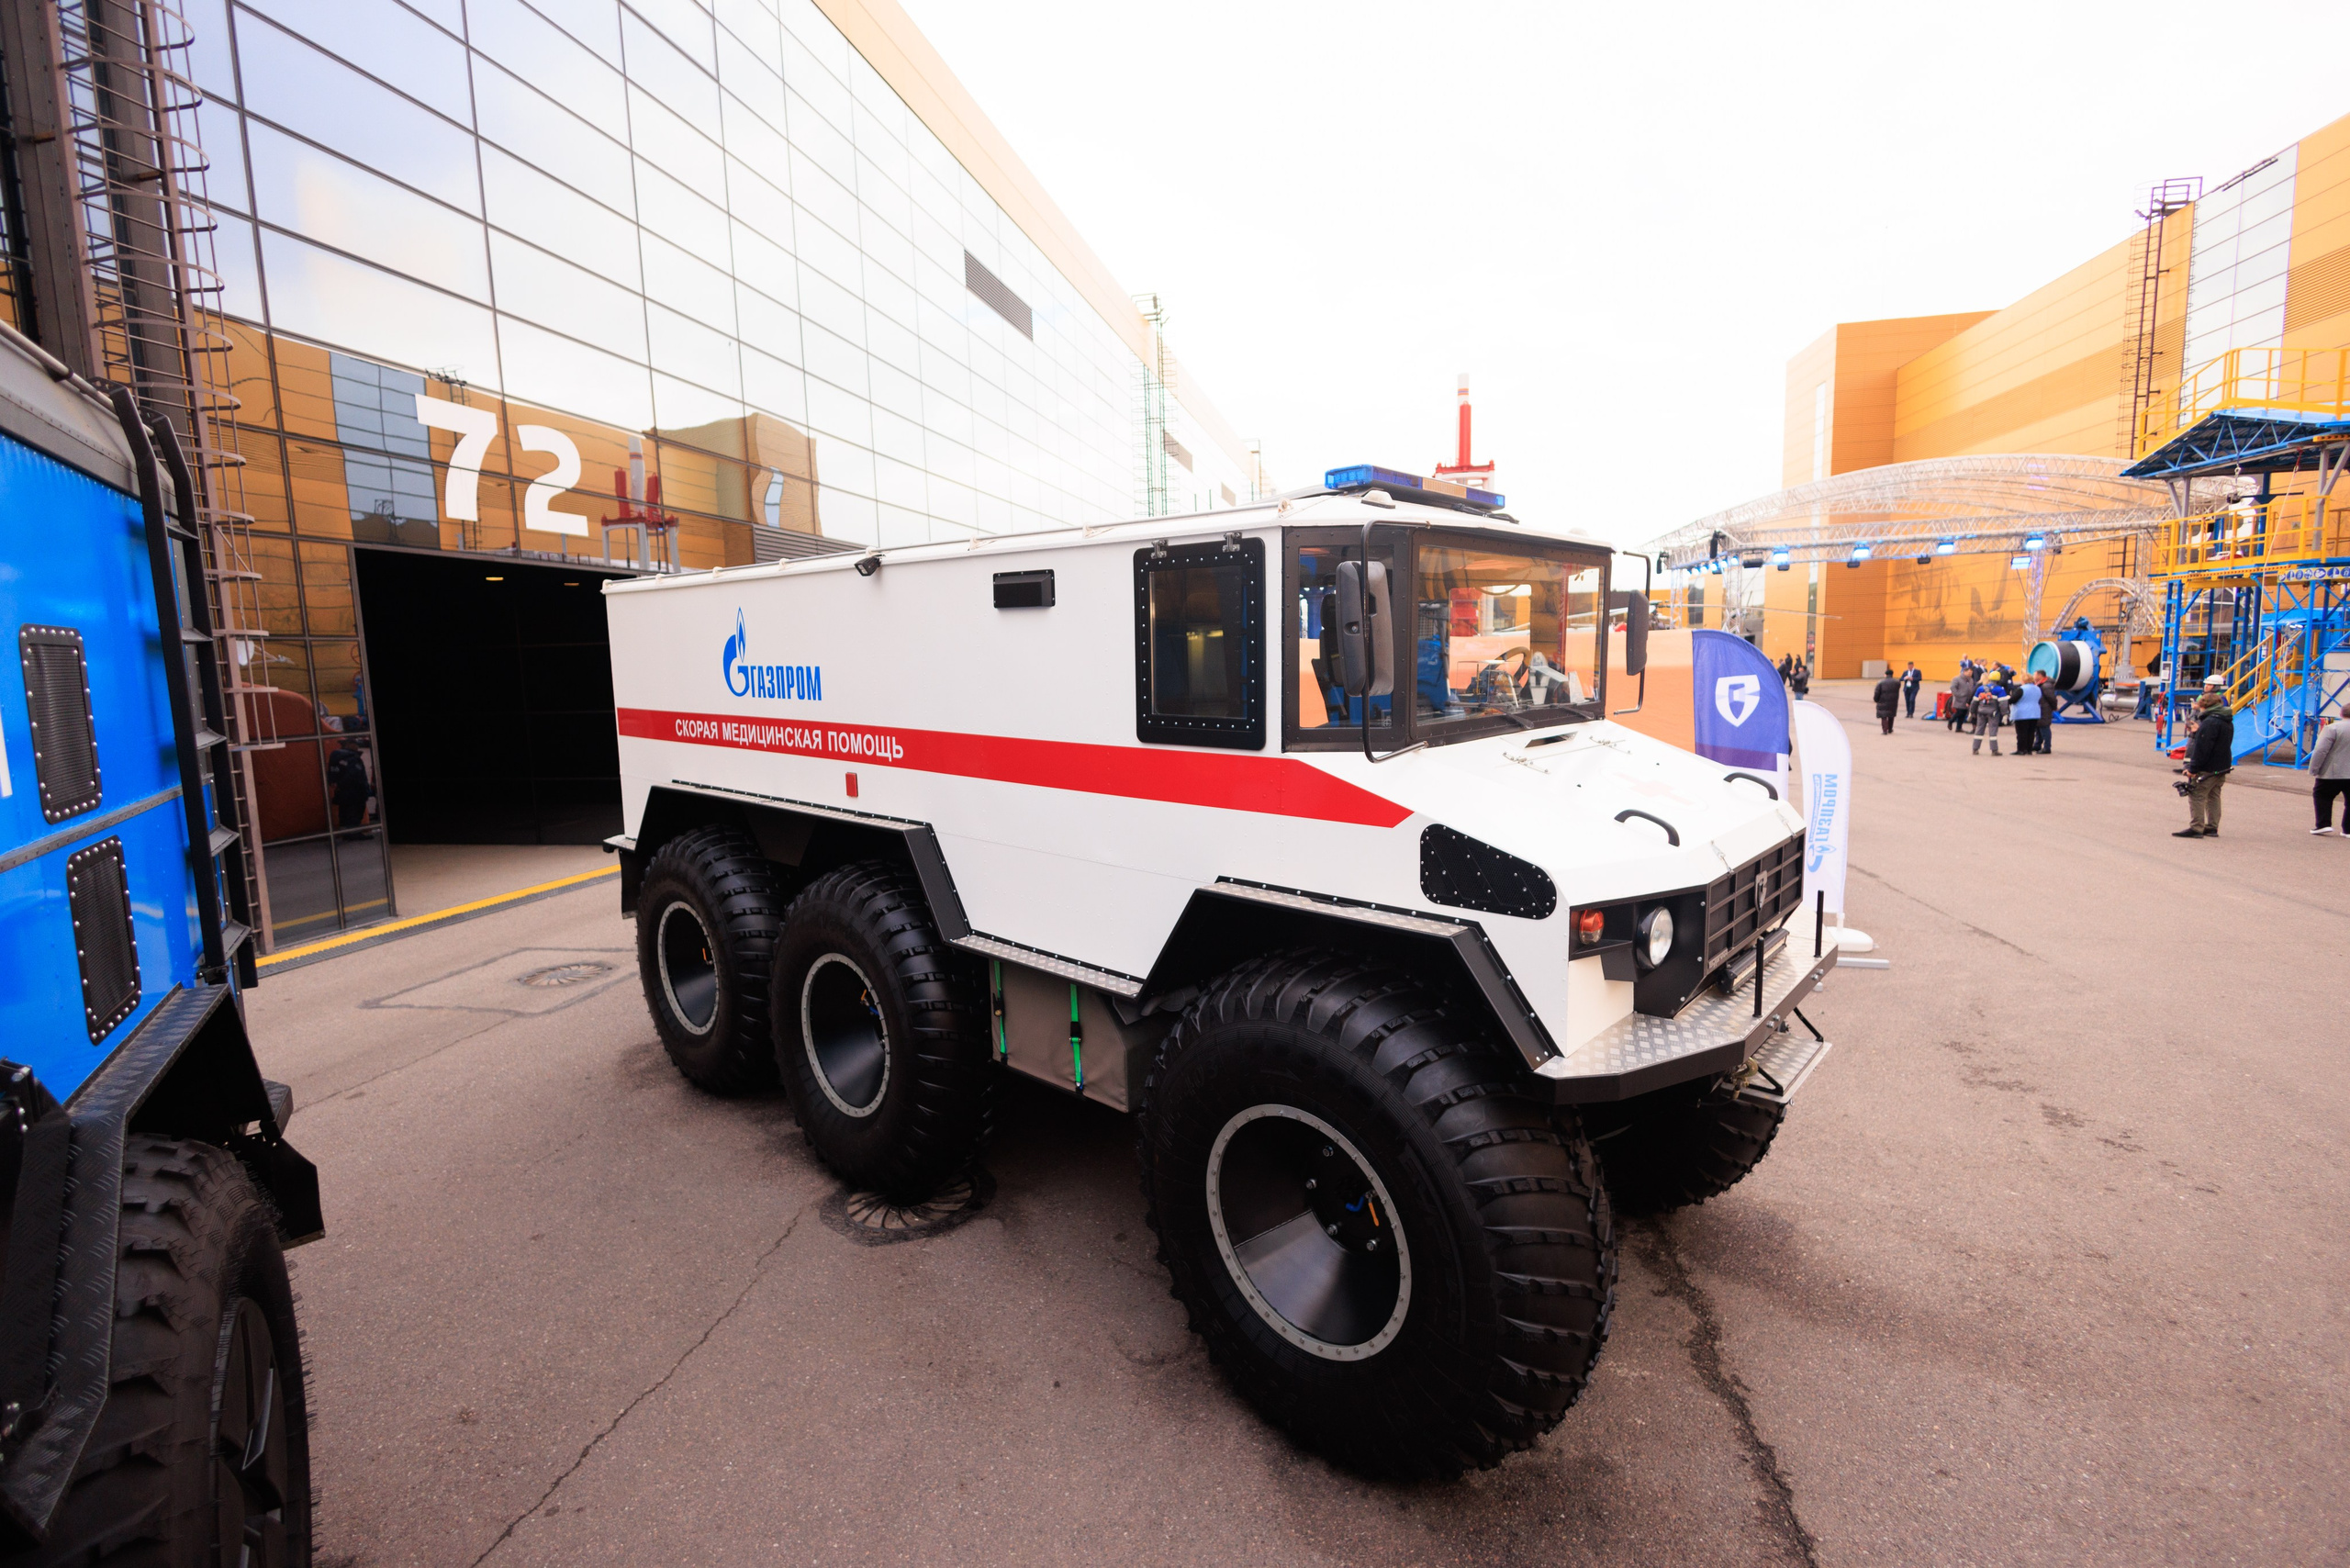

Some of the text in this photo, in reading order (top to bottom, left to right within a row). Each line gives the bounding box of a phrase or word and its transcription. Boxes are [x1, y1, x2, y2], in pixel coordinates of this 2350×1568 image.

[415, 393, 588, 537] 72
[750, 666, 822, 700] ГАЗПРОМ
[675, 719, 904, 762] СКОРАЯ МЕДИЦИНСКАЯ ПОМОЩЬ
